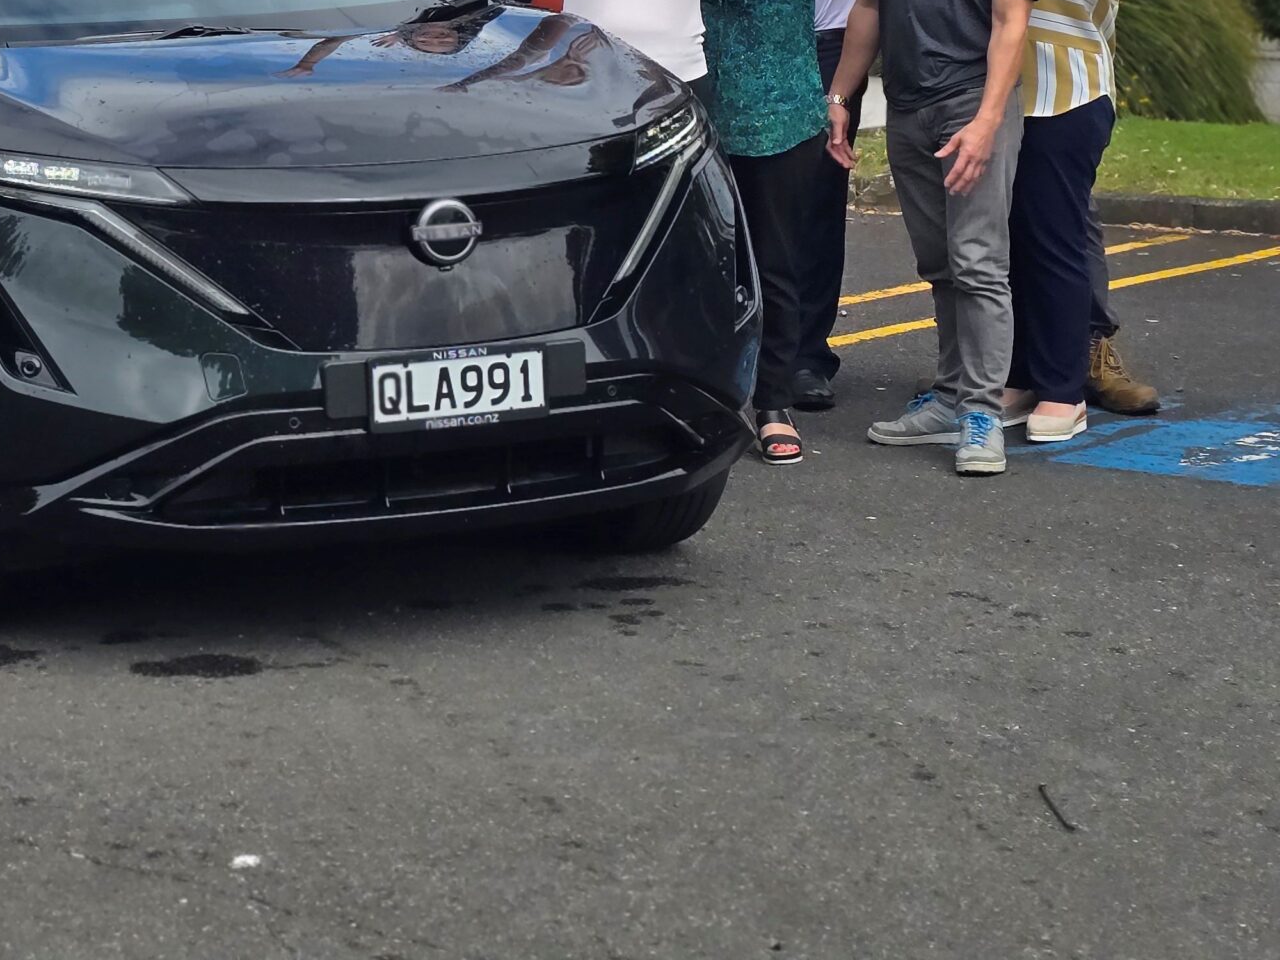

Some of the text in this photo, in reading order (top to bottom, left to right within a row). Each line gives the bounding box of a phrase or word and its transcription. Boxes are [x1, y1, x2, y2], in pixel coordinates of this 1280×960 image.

[414, 226, 482, 241] NISSAN
[433, 347, 488, 360] NISSAN
[378, 359, 533, 416] QLA991
[426, 412, 500, 430] nissan.co.nz
